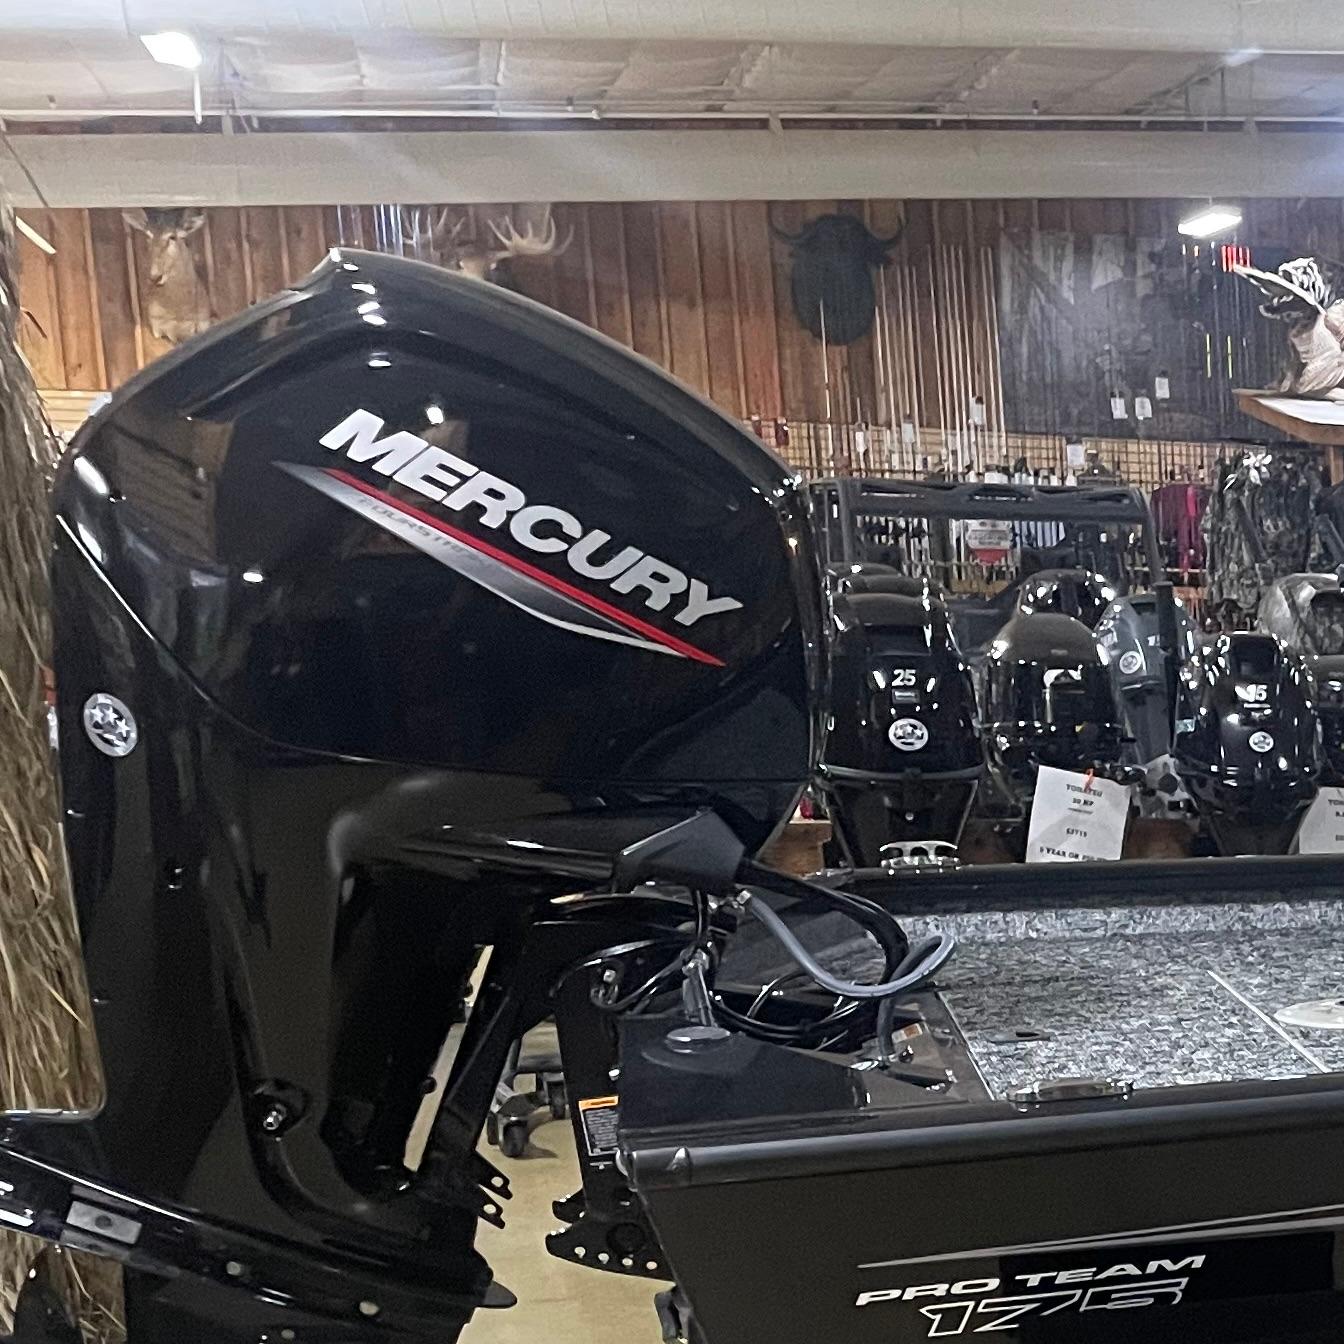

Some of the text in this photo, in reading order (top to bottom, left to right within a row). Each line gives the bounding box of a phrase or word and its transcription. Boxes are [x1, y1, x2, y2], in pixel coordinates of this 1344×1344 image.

[319, 408, 743, 627] MERCURY
[892, 669, 917, 687] 25
[855, 1254, 1207, 1306] PRO TEAM
[918, 1277, 1189, 1337] 175
